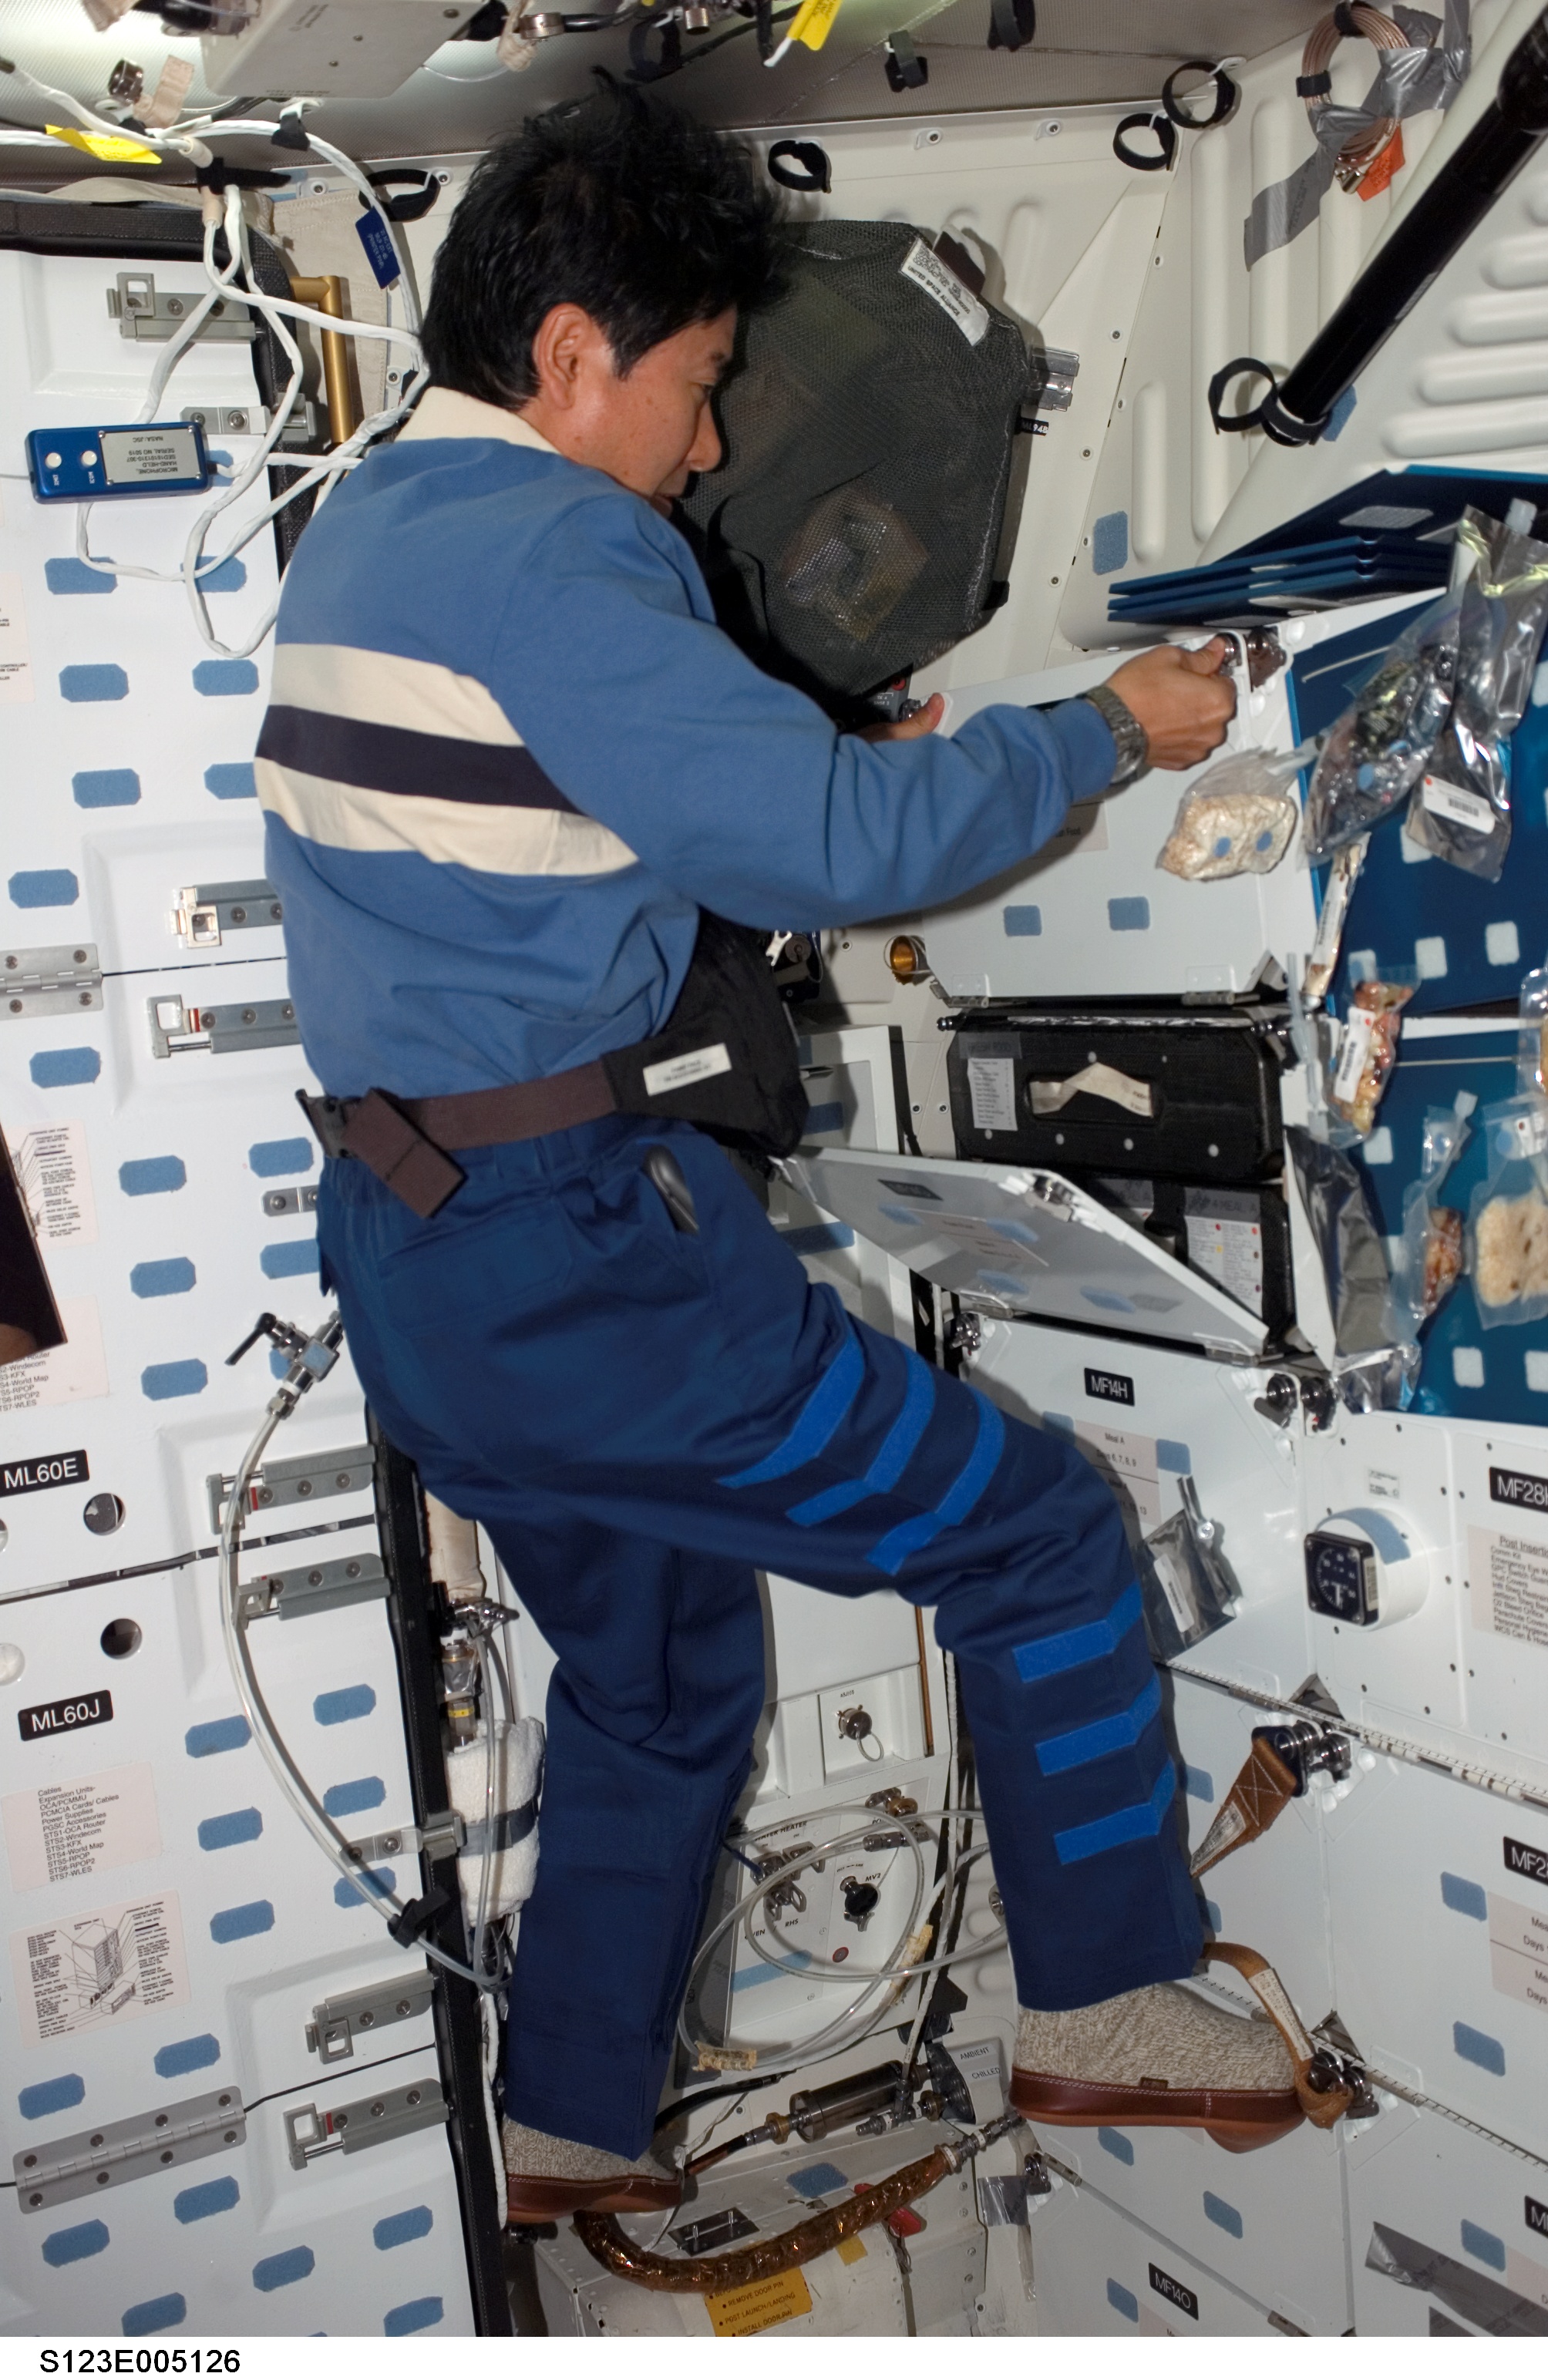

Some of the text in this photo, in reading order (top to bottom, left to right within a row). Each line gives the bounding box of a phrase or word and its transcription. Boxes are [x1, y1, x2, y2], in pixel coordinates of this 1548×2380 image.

[926, 279, 941, 295] SPACE
[1090, 1374, 1129, 1400] MF14H
[5, 1457, 79, 1489] ML60E
[1499, 1535, 1518, 1550] Post
[32, 1699, 100, 1733] ML60J
[38, 1787, 62, 1797] Cables
[39, 1790, 75, 1804] Expansion
[39, 1794, 87, 1811] OCA/PCMMU
[41, 1806, 71, 1818] PCMCIA
[96, 1794, 119, 1805] Cables
[42, 1807, 94, 1825] Power Supplies
[42, 1812, 106, 1832] PGSC Accessories
[83, 1820, 106, 1830] Router
[780, 1820, 808, 1834] HEATER
[89, 1842, 105, 1851] Map
[1512, 1846, 1548, 1879] MF2
[865, 1873, 881, 1882] MV2
[785, 1918, 799, 1928] RHS
[1523, 1935, 1544, 1952] Days
[1526, 1988, 1548, 2005] Days
[960, 2046, 989, 2060] AMBIENT
[971, 2067, 1001, 2079] CHILLED
[728, 2280, 784, 2307] REMOVE DOOR PIN
[725, 2292, 796, 2325] POST LAUNCH/LANDING
[738, 2309, 793, 2335] INSTALL DOOR PIN
